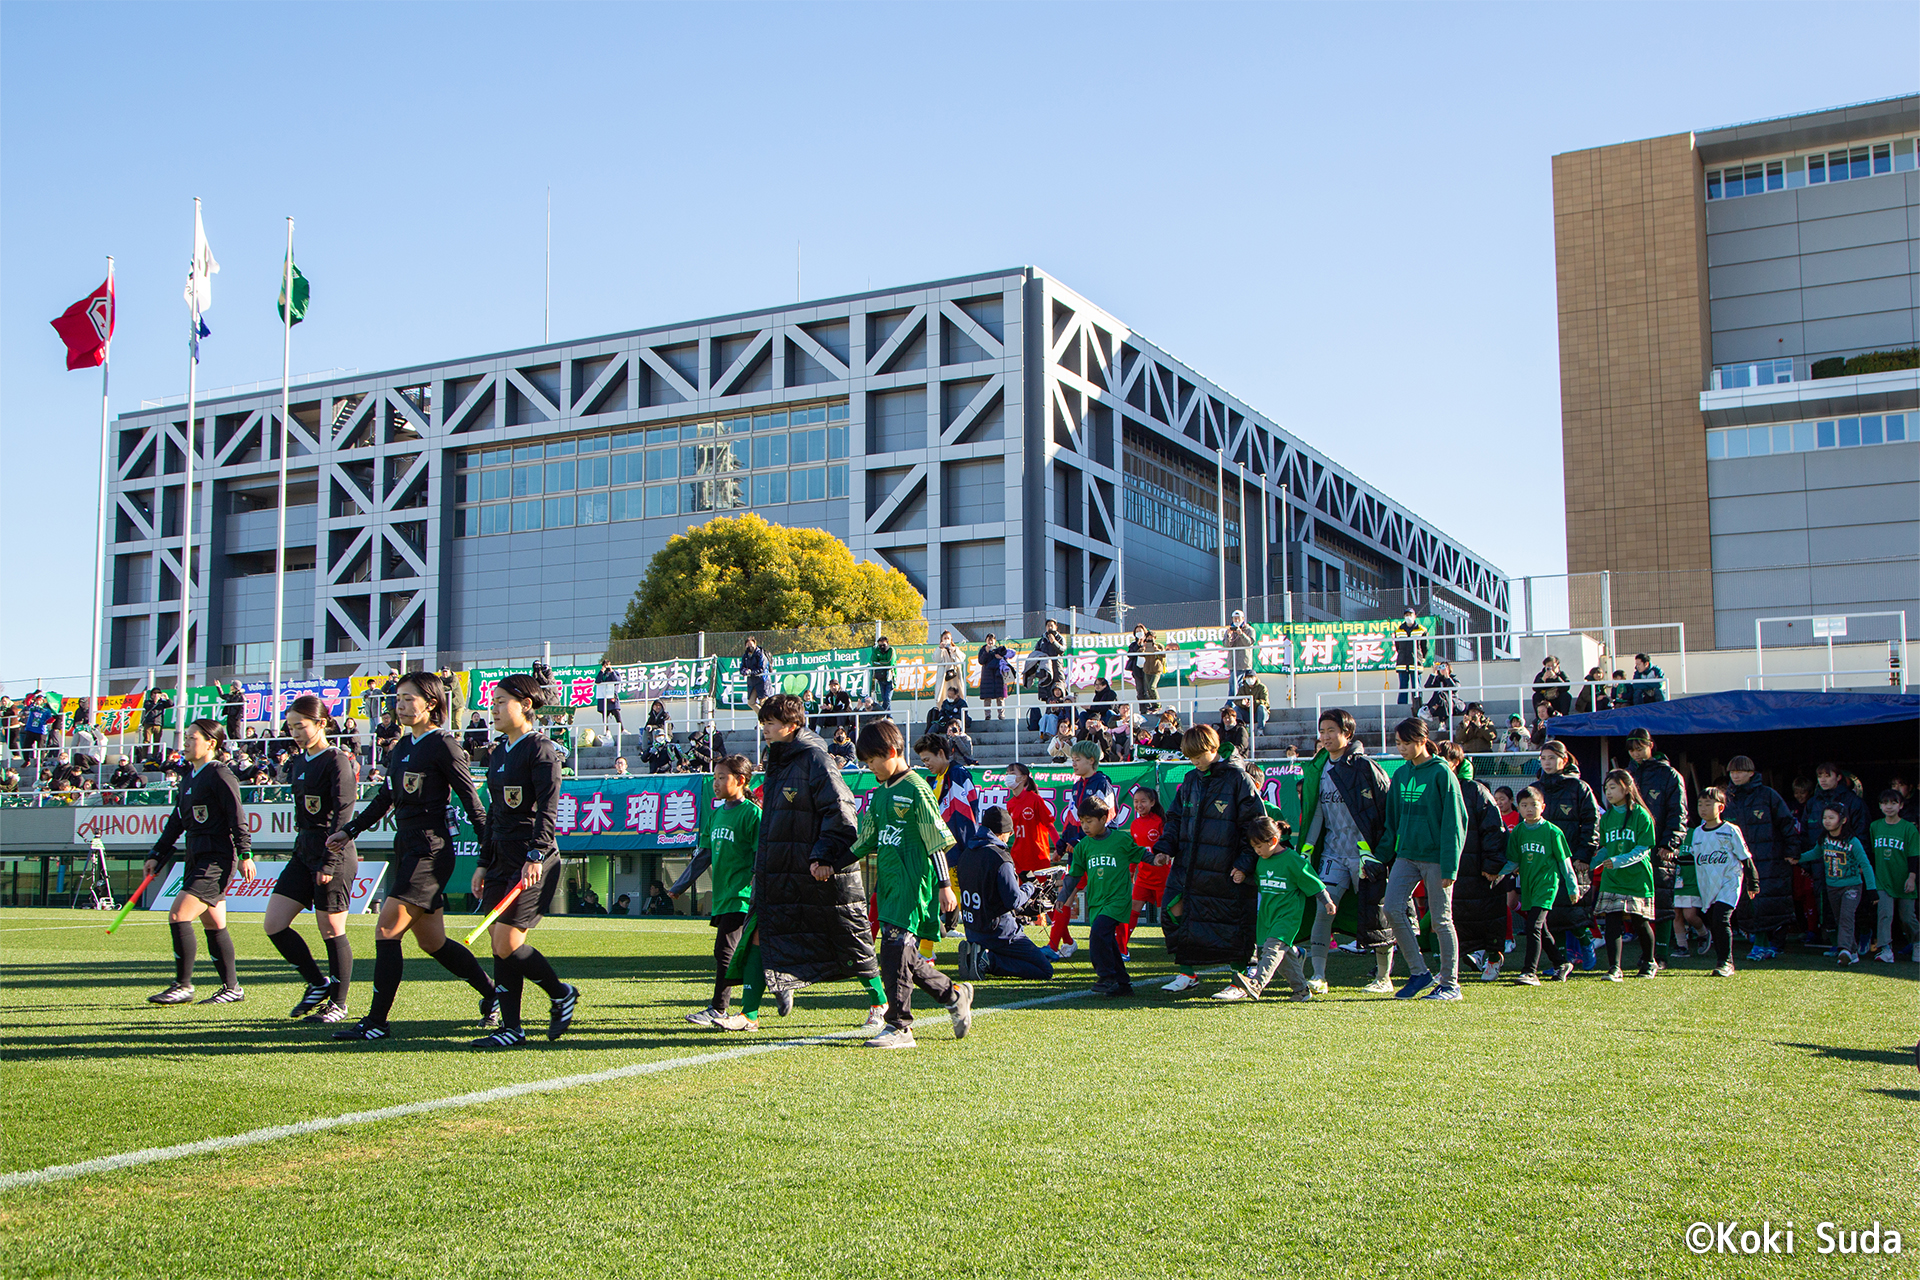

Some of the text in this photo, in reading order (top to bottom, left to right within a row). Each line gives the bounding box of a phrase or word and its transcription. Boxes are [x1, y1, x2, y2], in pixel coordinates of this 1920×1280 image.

[1272, 621, 1402, 635] KASHIMURA NAN
[1071, 633, 1136, 648] HORIUC
[969, 644, 980, 652] for
[1258, 632, 1397, 666] 柏村菜
[772, 650, 860, 666] ith an honest heart
[553, 668, 572, 677] aiting
[573, 668, 583, 677] for
[584, 668, 596, 677] you
[1302, 664, 1341, 673] through
[1265, 764, 1304, 777] CHALLE
[625, 790, 697, 833] 瑠美
[1015, 825, 1026, 838] 21
